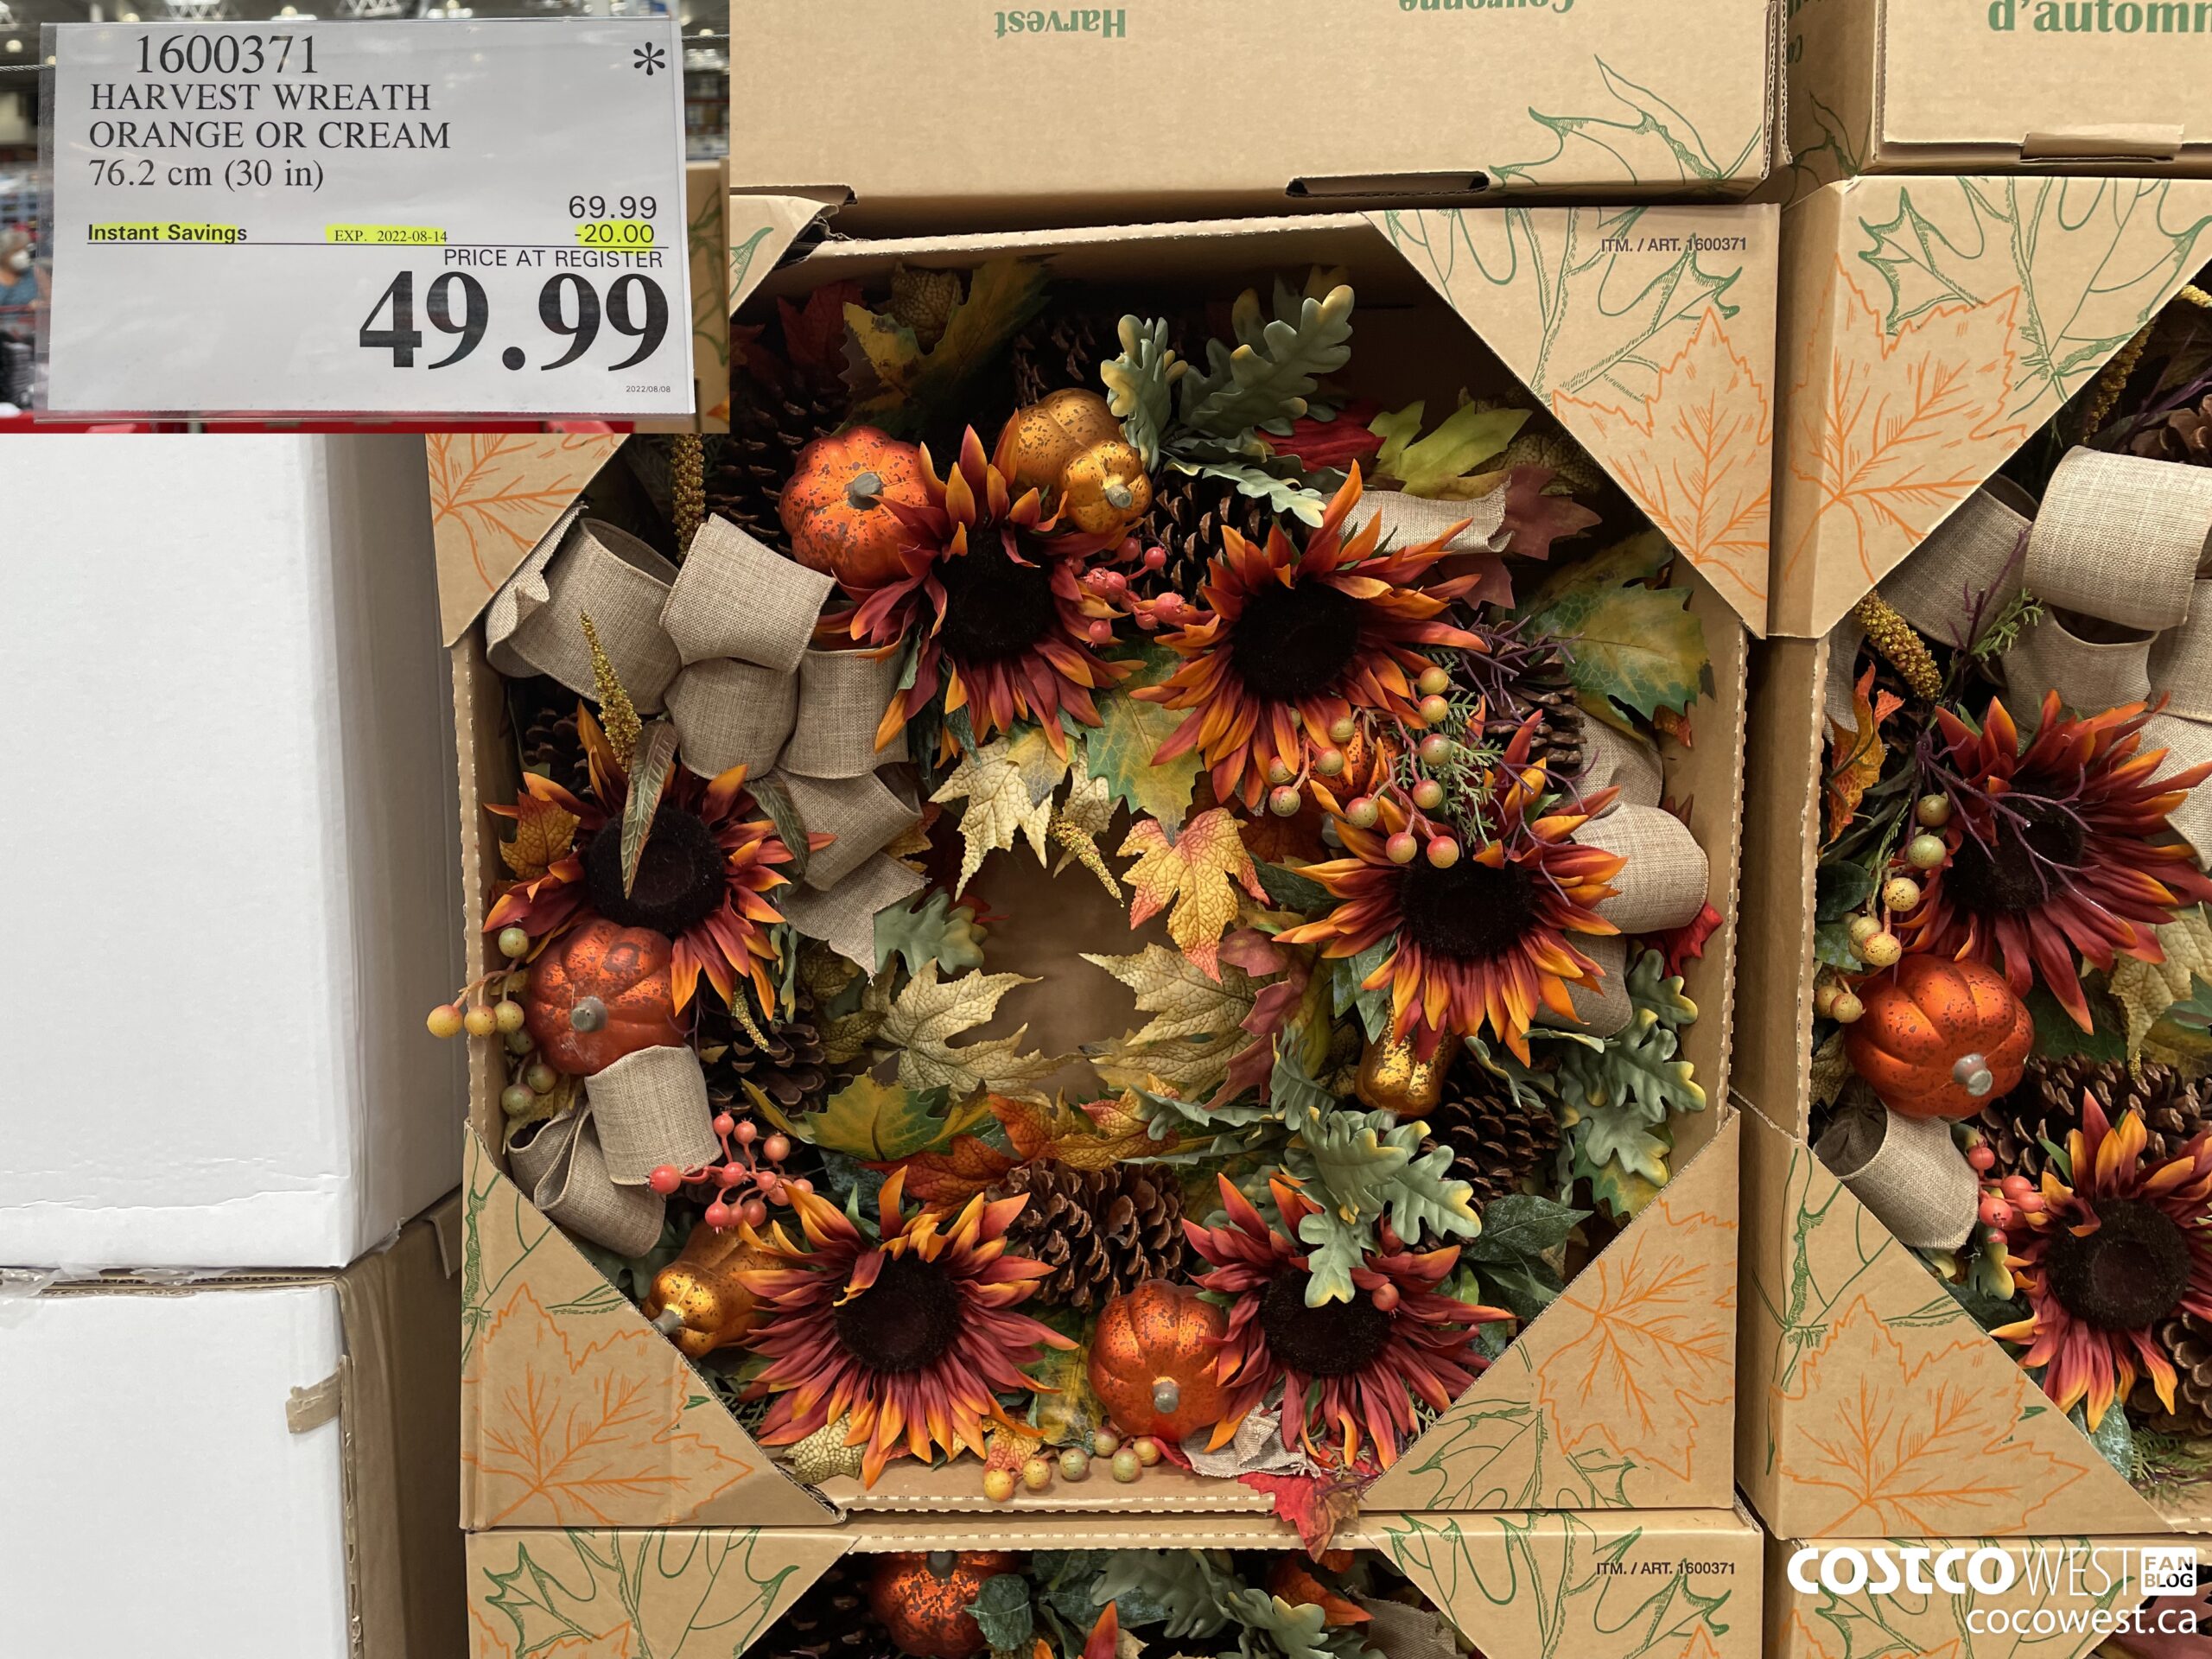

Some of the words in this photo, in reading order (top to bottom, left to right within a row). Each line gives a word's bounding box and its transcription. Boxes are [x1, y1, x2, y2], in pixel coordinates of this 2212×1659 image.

[994, 9, 1126, 39] Harvest
[137, 35, 318, 74] 1600371
[90, 83, 260, 111] HARVEST
[271, 84, 431, 111] WREATH
[89, 121, 245, 149] ORANGE
[256, 121, 307, 149] OR
[318, 121, 450, 149] CREAM
[89, 159, 156, 187] 76.2
[168, 167, 213, 187] cm
[225, 159, 272, 193] (30
[284, 159, 324, 193] in)
[569, 195, 657, 219] 69.99
[88, 224, 160, 241] Instant
[168, 224, 247, 244] Savings
[334, 230, 367, 242] EXP.
[377, 230, 448, 243] 2022-08-14
[575, 224, 655, 245] -20.00
[1601, 238, 1633, 252] ITM.
[1637, 238, 1644, 252] /
[1647, 238, 1681, 251] ART.
[1686, 237, 1746, 251] 1600371
[444, 249, 508, 267] PRICE
[517, 250, 547, 267] AT
[555, 250, 664, 269] REGISTER
[359, 270, 669, 372] 49.99
[1597, 1561, 1626, 1575] ITM.
[1630, 1561, 1637, 1575] /
[1640, 1561, 1673, 1575] ART.
[1677, 1561, 1735, 1575] 1600371
